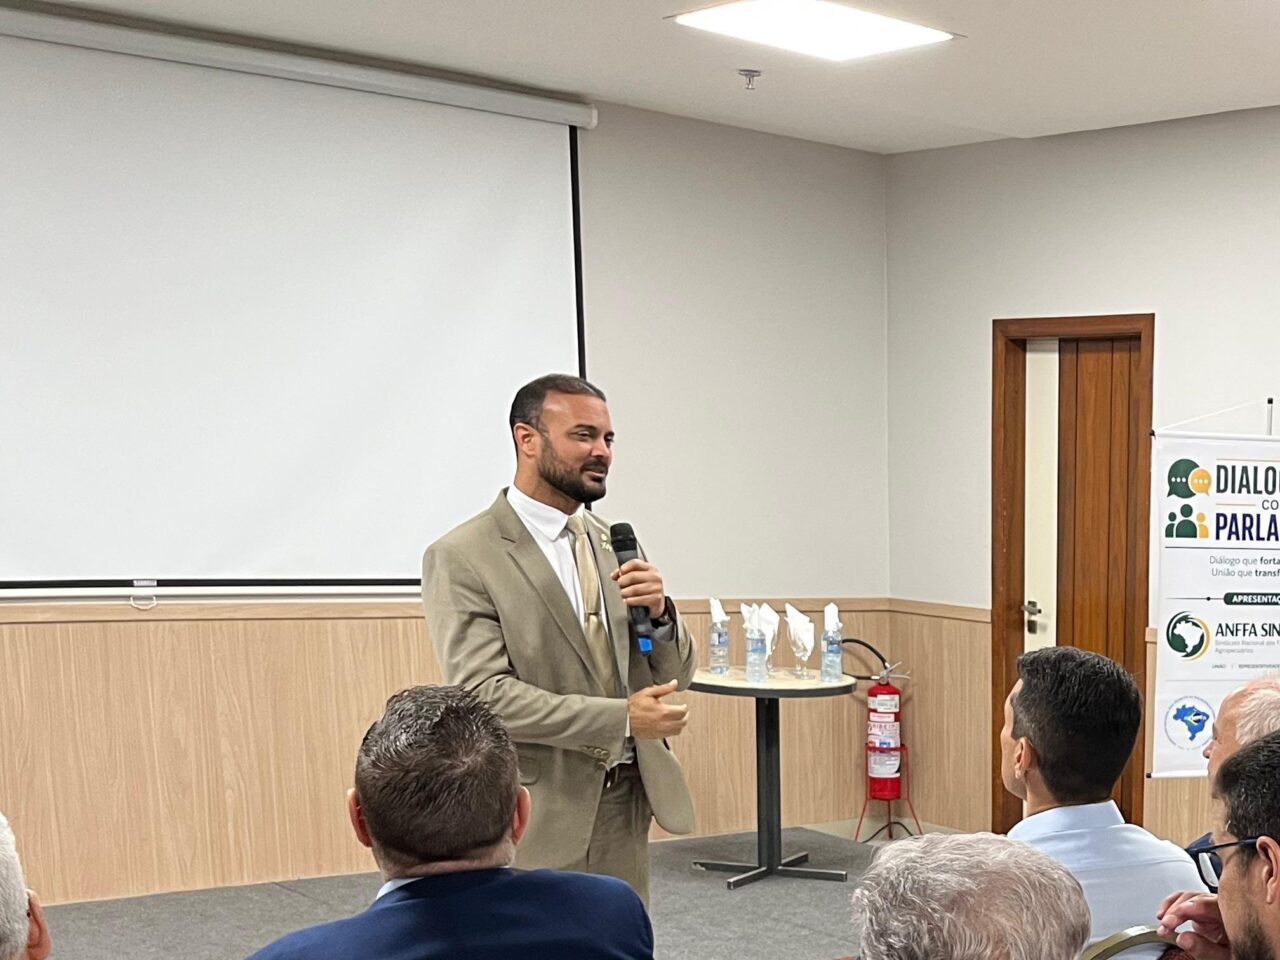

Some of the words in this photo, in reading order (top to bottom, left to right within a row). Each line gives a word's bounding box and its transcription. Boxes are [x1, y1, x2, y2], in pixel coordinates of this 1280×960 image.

[1209, 555, 1241, 566] Diálogo
[1242, 558, 1258, 566] que
[1211, 568, 1236, 577] União
[1237, 569, 1253, 578] que
[1215, 622, 1258, 637] ANFFA
